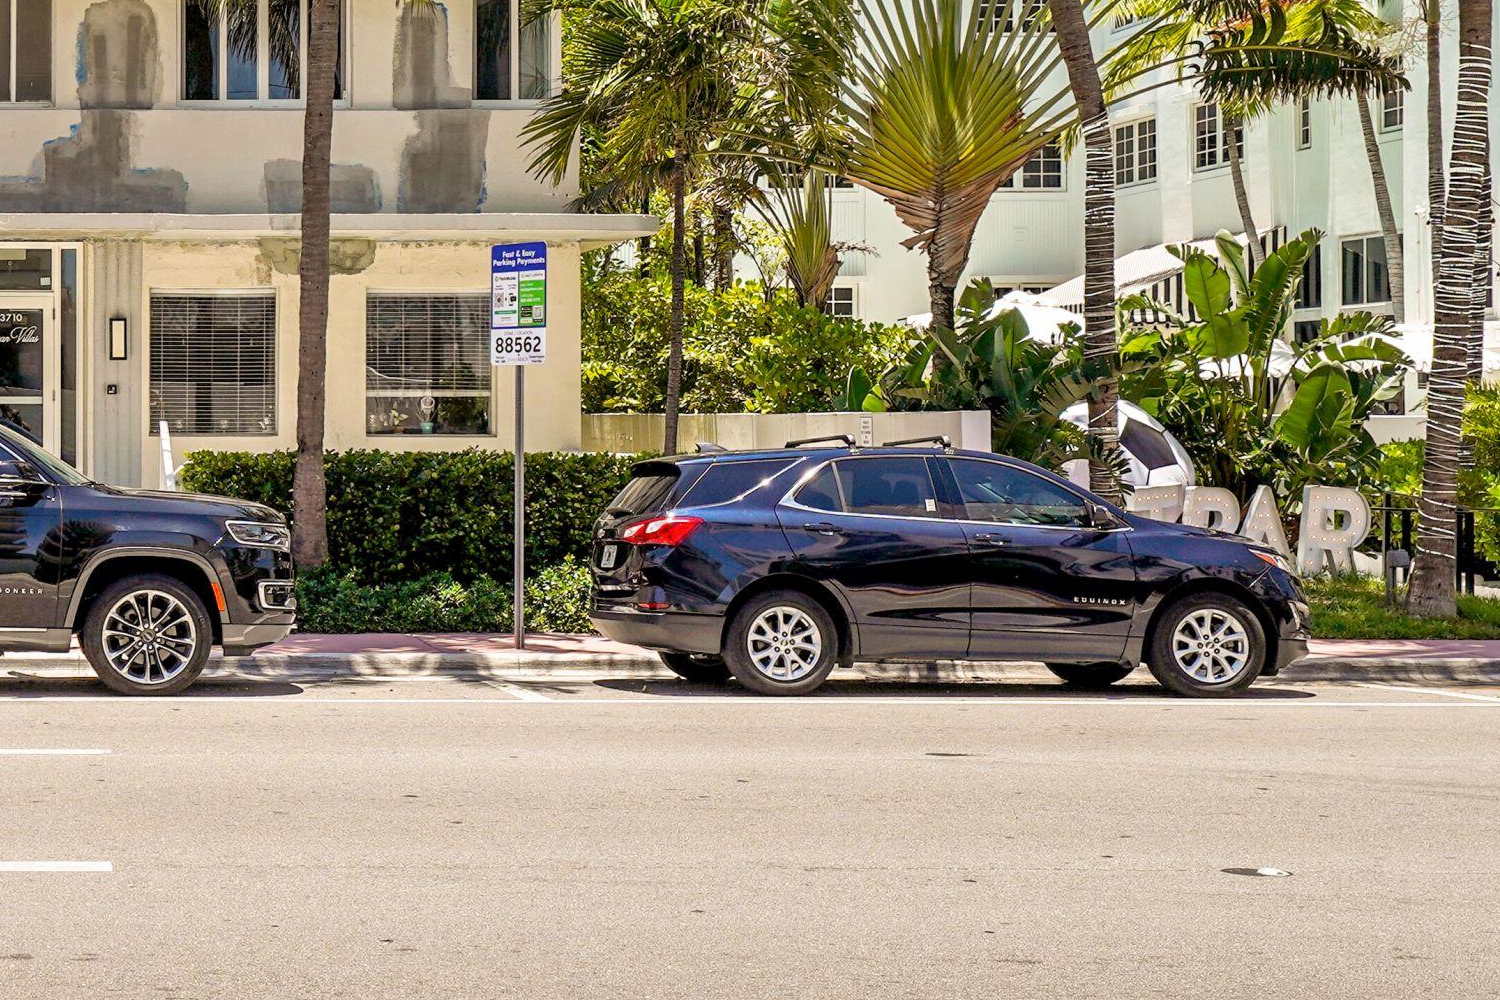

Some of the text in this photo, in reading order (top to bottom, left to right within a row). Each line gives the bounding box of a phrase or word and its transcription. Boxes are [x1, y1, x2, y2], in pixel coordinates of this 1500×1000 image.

[521, 249, 536, 258] Easy
[492, 257, 545, 267] Parking Payments
[0, 313, 23, 322] 3710
[9, 325, 40, 344] Villas
[495, 336, 541, 353] 88562
[1073, 596, 1126, 605] EQUINOX
